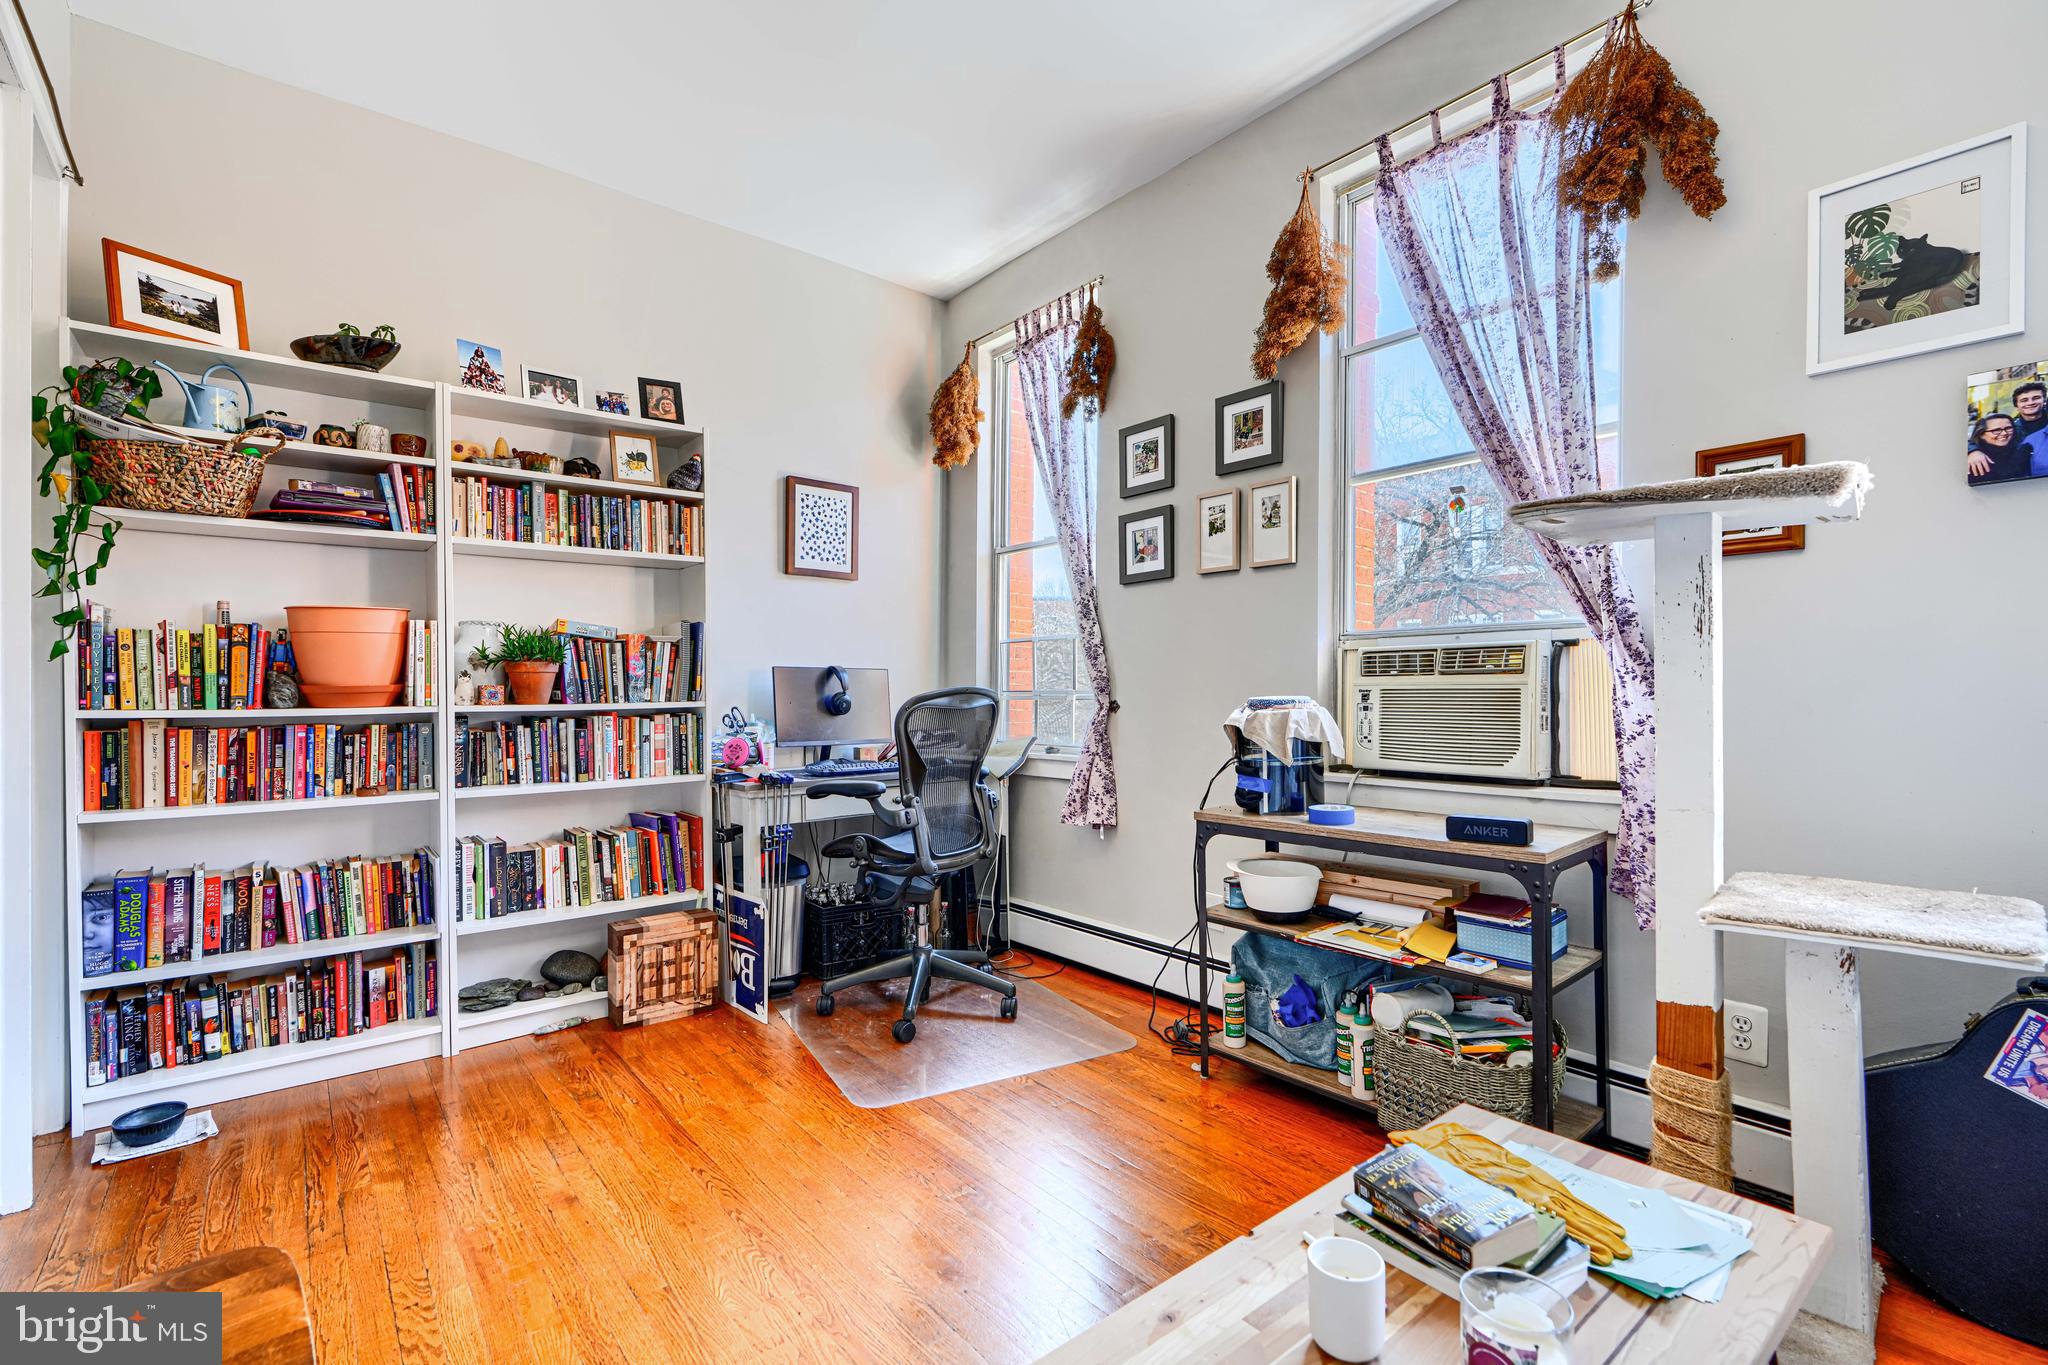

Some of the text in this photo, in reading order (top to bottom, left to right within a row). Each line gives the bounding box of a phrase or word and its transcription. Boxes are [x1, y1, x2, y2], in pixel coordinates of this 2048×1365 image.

[93, 634, 102, 692] ODYSSEY
[455, 745, 463, 776] NARNIA
[1464, 825, 1509, 838] ANKER
[579, 845, 587, 860] CAPITAL
[173, 878, 184, 923] STEPHEN KING
[206, 884, 214, 908] NESS
[238, 880, 248, 912] WOOL
[119, 900, 130, 934] ADAMS
[130, 893, 142, 938] DOUGLAS
[124, 1016, 134, 1042] KING
[1997, 1020, 2042, 1078] DREAMS UNITE US
